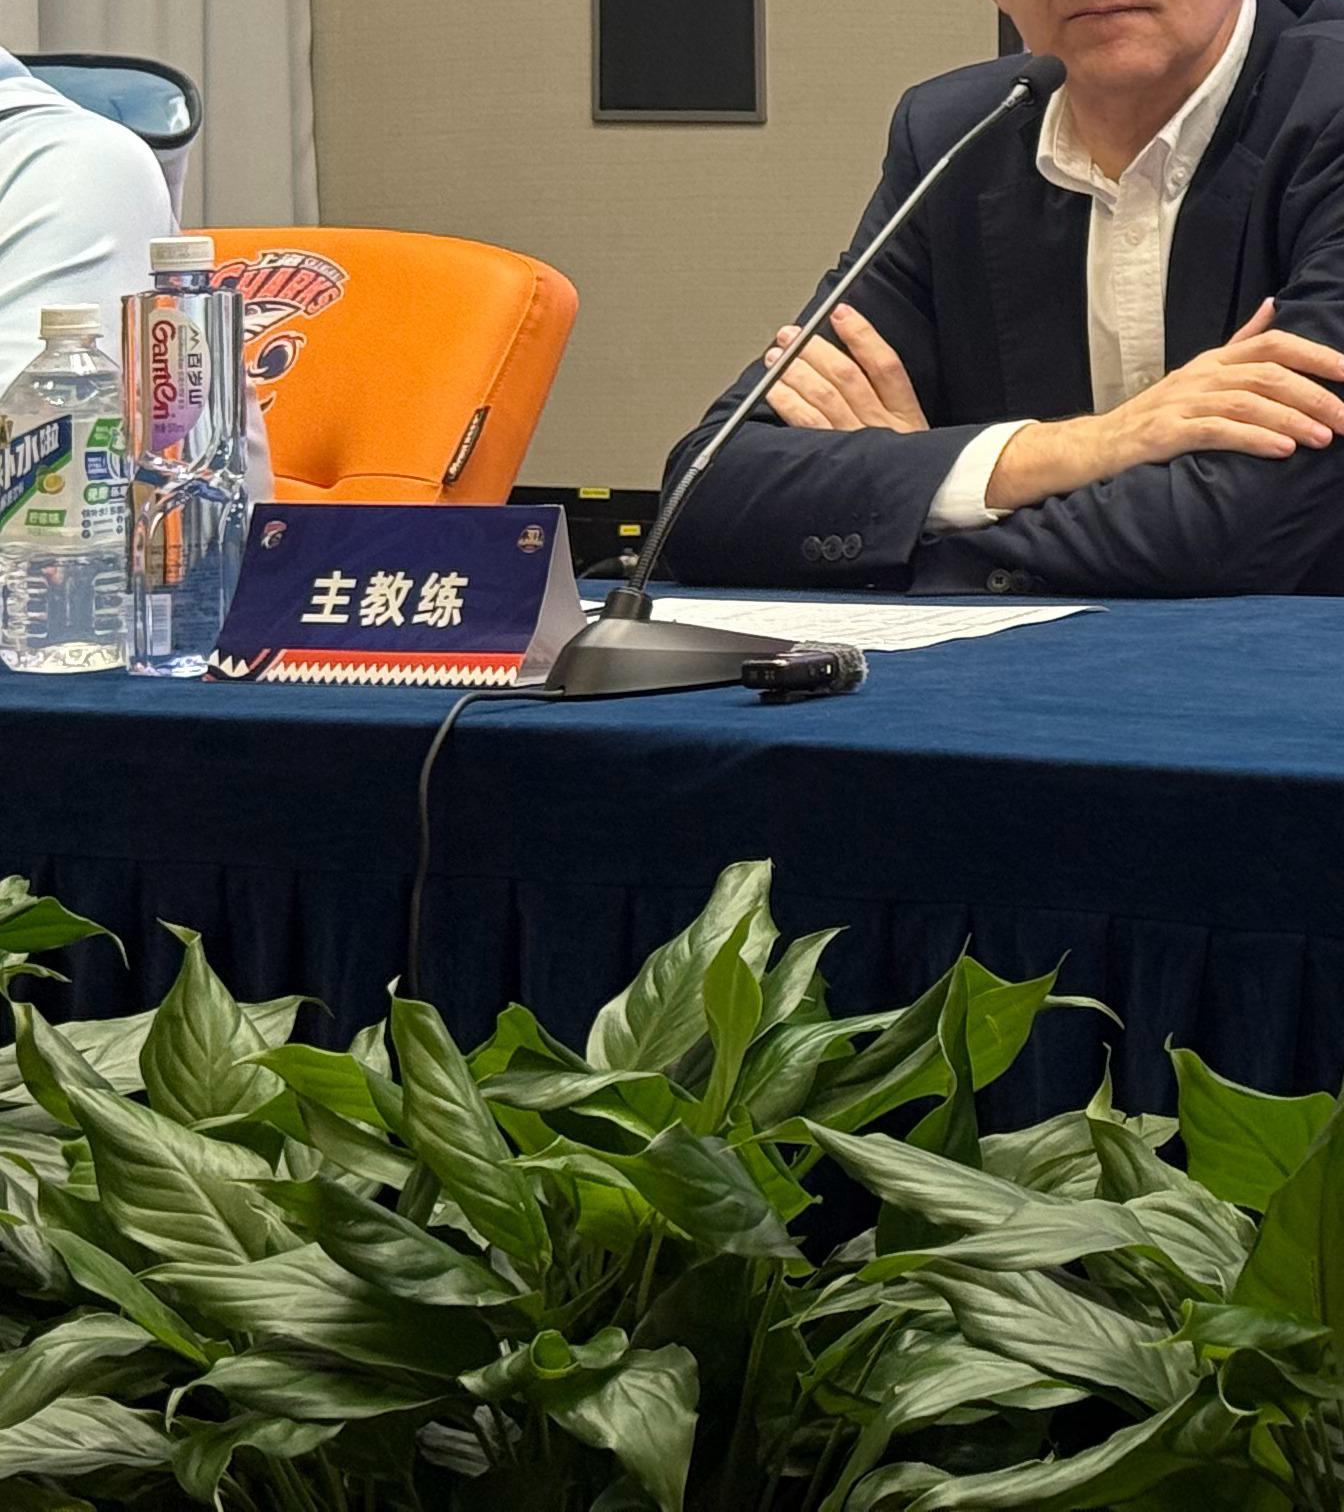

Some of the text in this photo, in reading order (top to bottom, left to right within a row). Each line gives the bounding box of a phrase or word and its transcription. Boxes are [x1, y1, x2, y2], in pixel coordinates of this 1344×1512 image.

[187, 353, 204, 405] 百岁山
[301, 570, 469, 630] 主教练
